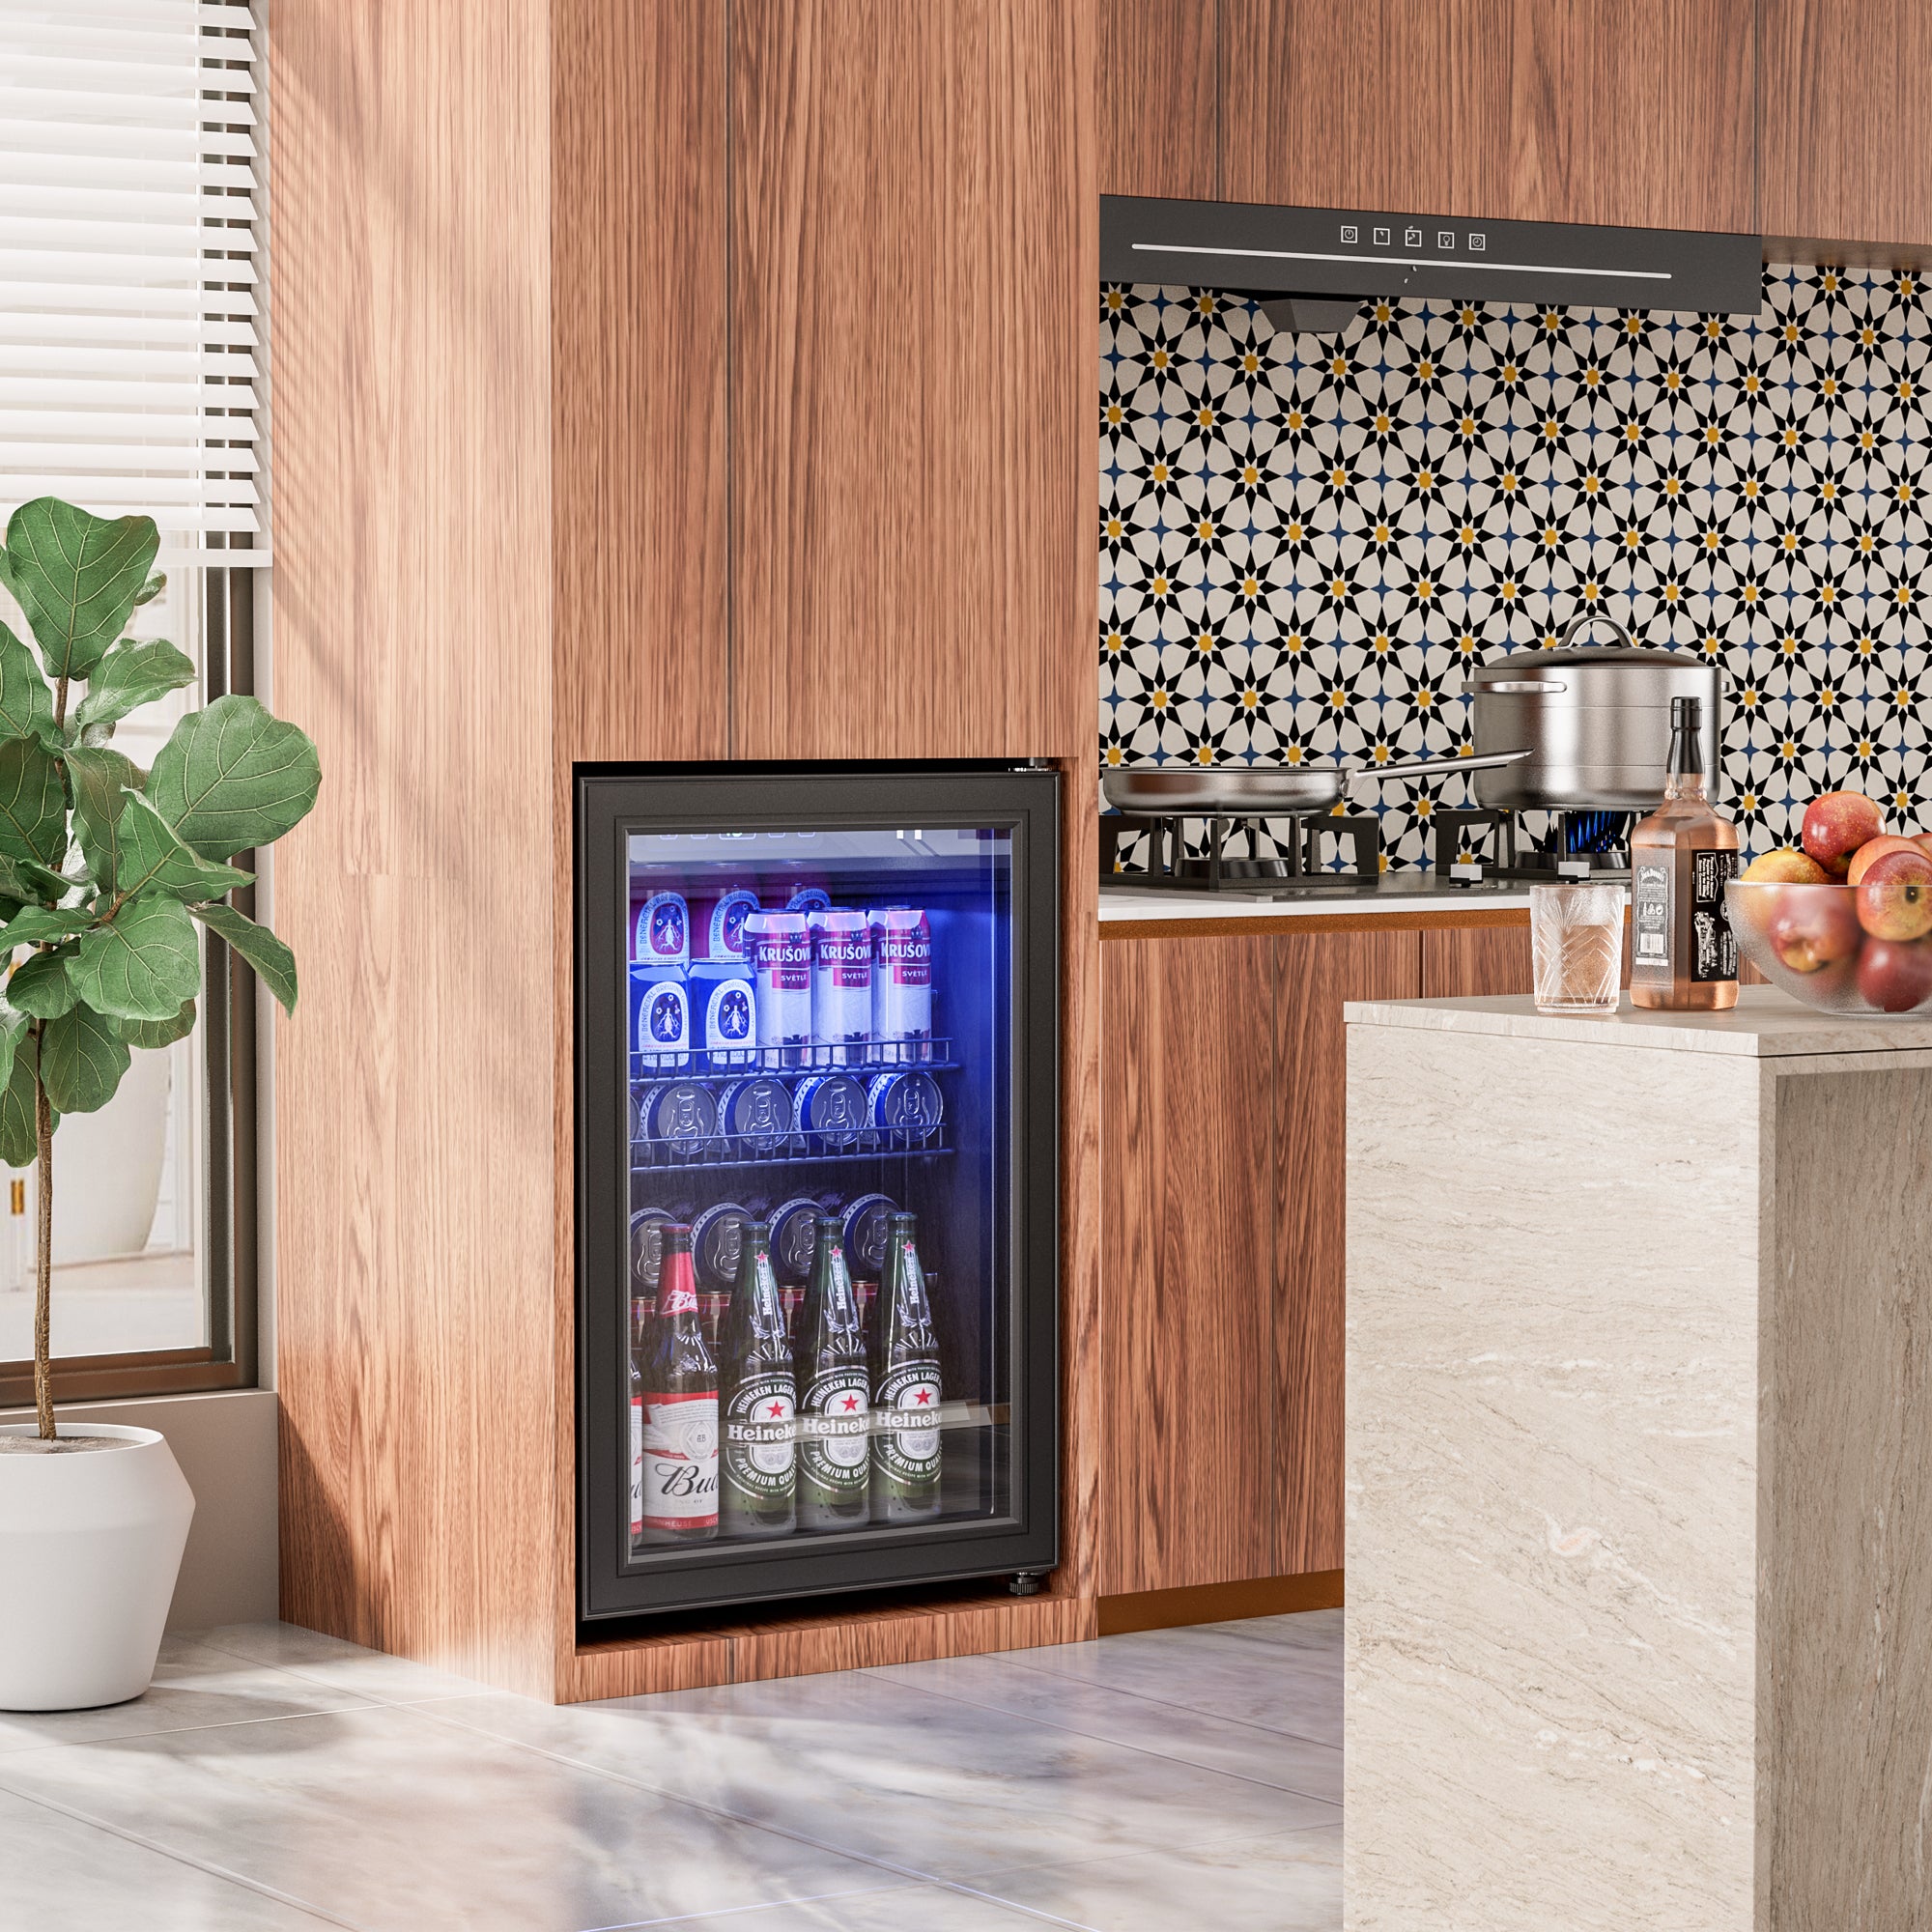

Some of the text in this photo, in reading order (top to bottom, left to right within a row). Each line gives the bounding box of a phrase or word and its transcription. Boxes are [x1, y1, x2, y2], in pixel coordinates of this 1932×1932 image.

[736, 1385, 772, 1413] HEINEKEN
[774, 1384, 794, 1398] LAGER
[810, 1378, 846, 1407] HEINEKEN
[847, 1378, 867, 1390] LAGER
[884, 1373, 919, 1401] HEINEKEN
[921, 1372, 940, 1383] LAGER
[810, 1451, 850, 1479] PREMIUM
[883, 1444, 923, 1471] PREMIUM
[735, 1459, 777, 1486] PREMIUM
